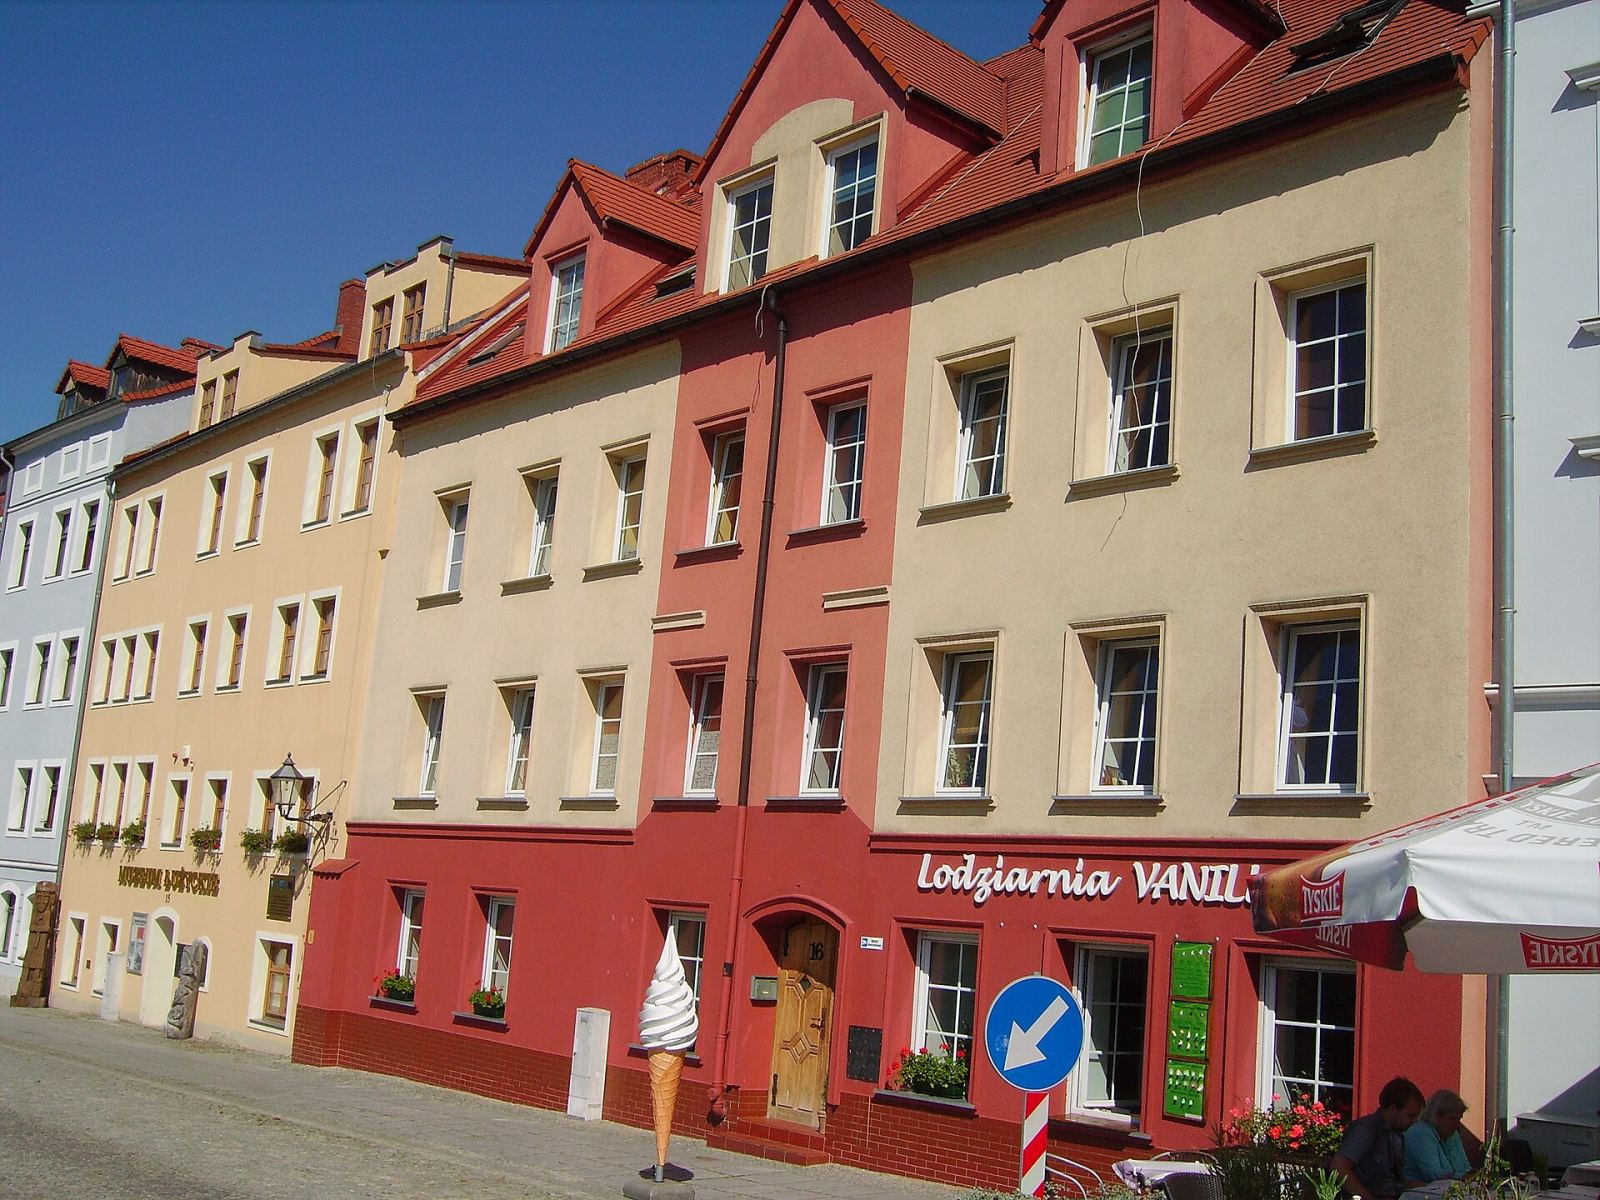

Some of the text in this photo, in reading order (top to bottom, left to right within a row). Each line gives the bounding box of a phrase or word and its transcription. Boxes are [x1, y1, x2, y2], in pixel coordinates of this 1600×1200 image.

[918, 853, 1122, 903] Lodziarnia
[1302, 880, 1341, 914] TYSKIE
[809, 942, 824, 961] 16
